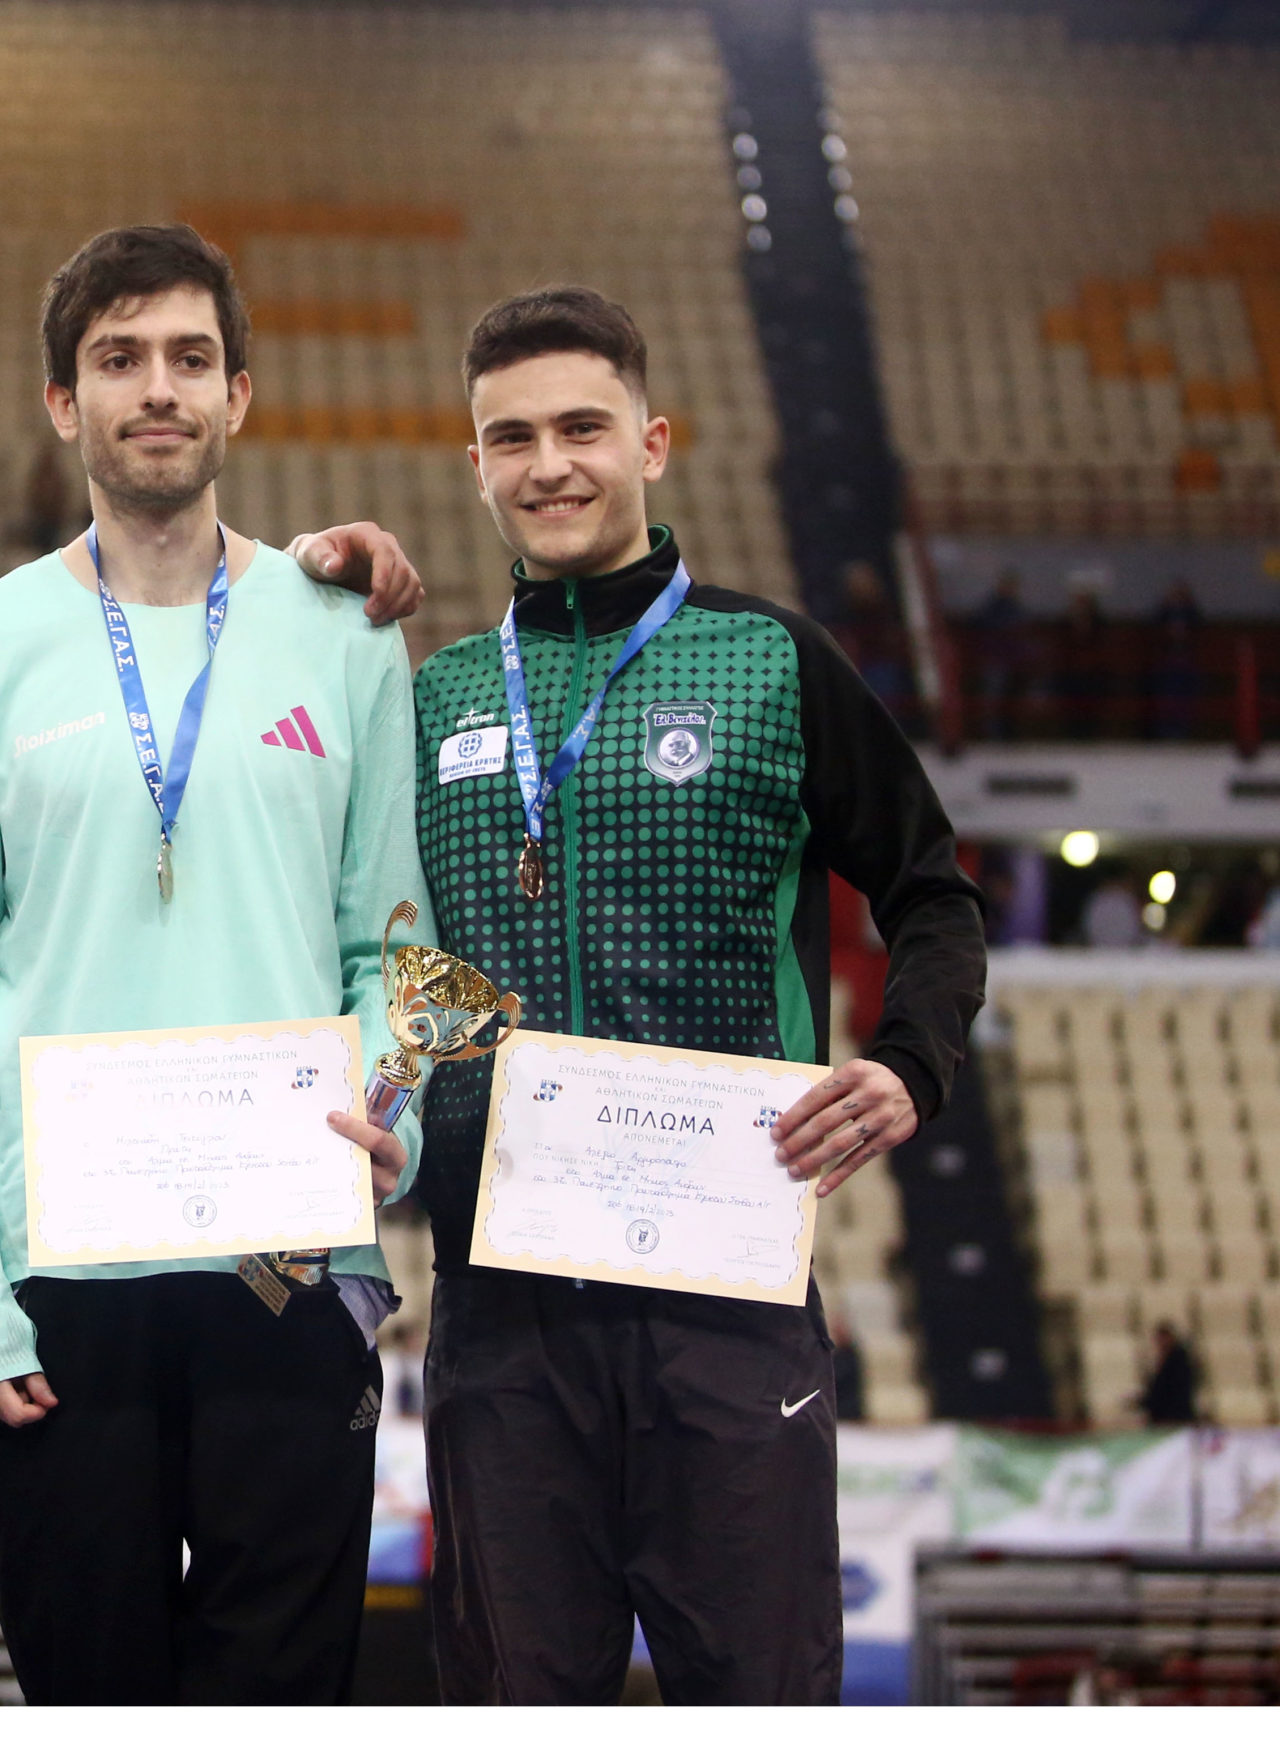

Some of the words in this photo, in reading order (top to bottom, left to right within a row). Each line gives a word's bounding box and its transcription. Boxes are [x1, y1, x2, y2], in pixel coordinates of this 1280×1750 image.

[102, 597, 136, 673] Σ.Ε.Γ.Α.Σ.
[511, 704, 539, 782] Σ.Ε.Γ.Α.Σ.
[155, 1055, 219, 1068] ΕΛΛΗΝΙΚΩΝ
[223, 1049, 299, 1064] ΓΥΜΝΑΣΤΙΚΩΝ
[195, 1070, 259, 1083] ΣΩΜΑΤΕΙΩΝ
[558, 1064, 622, 1080] ΣΥΝΔΕΣΜΟΣ
[625, 1072, 687, 1088] ΕΛΛΗΝΙΚΩΝ
[690, 1080, 765, 1097] ΓΥΜΝΑΣΤΙΚΩΝ
[594, 1086, 658, 1102] ΑΘΛΗΤΙΚΩΝ
[661, 1094, 723, 1110] ΣΩΜΑΤΕΙΩΝ
[596, 1105, 715, 1136] ΔΙΠΛΩΜΑ
[623, 1132, 687, 1148] ΑΠΟΝΕΜΕΤΑΙ
